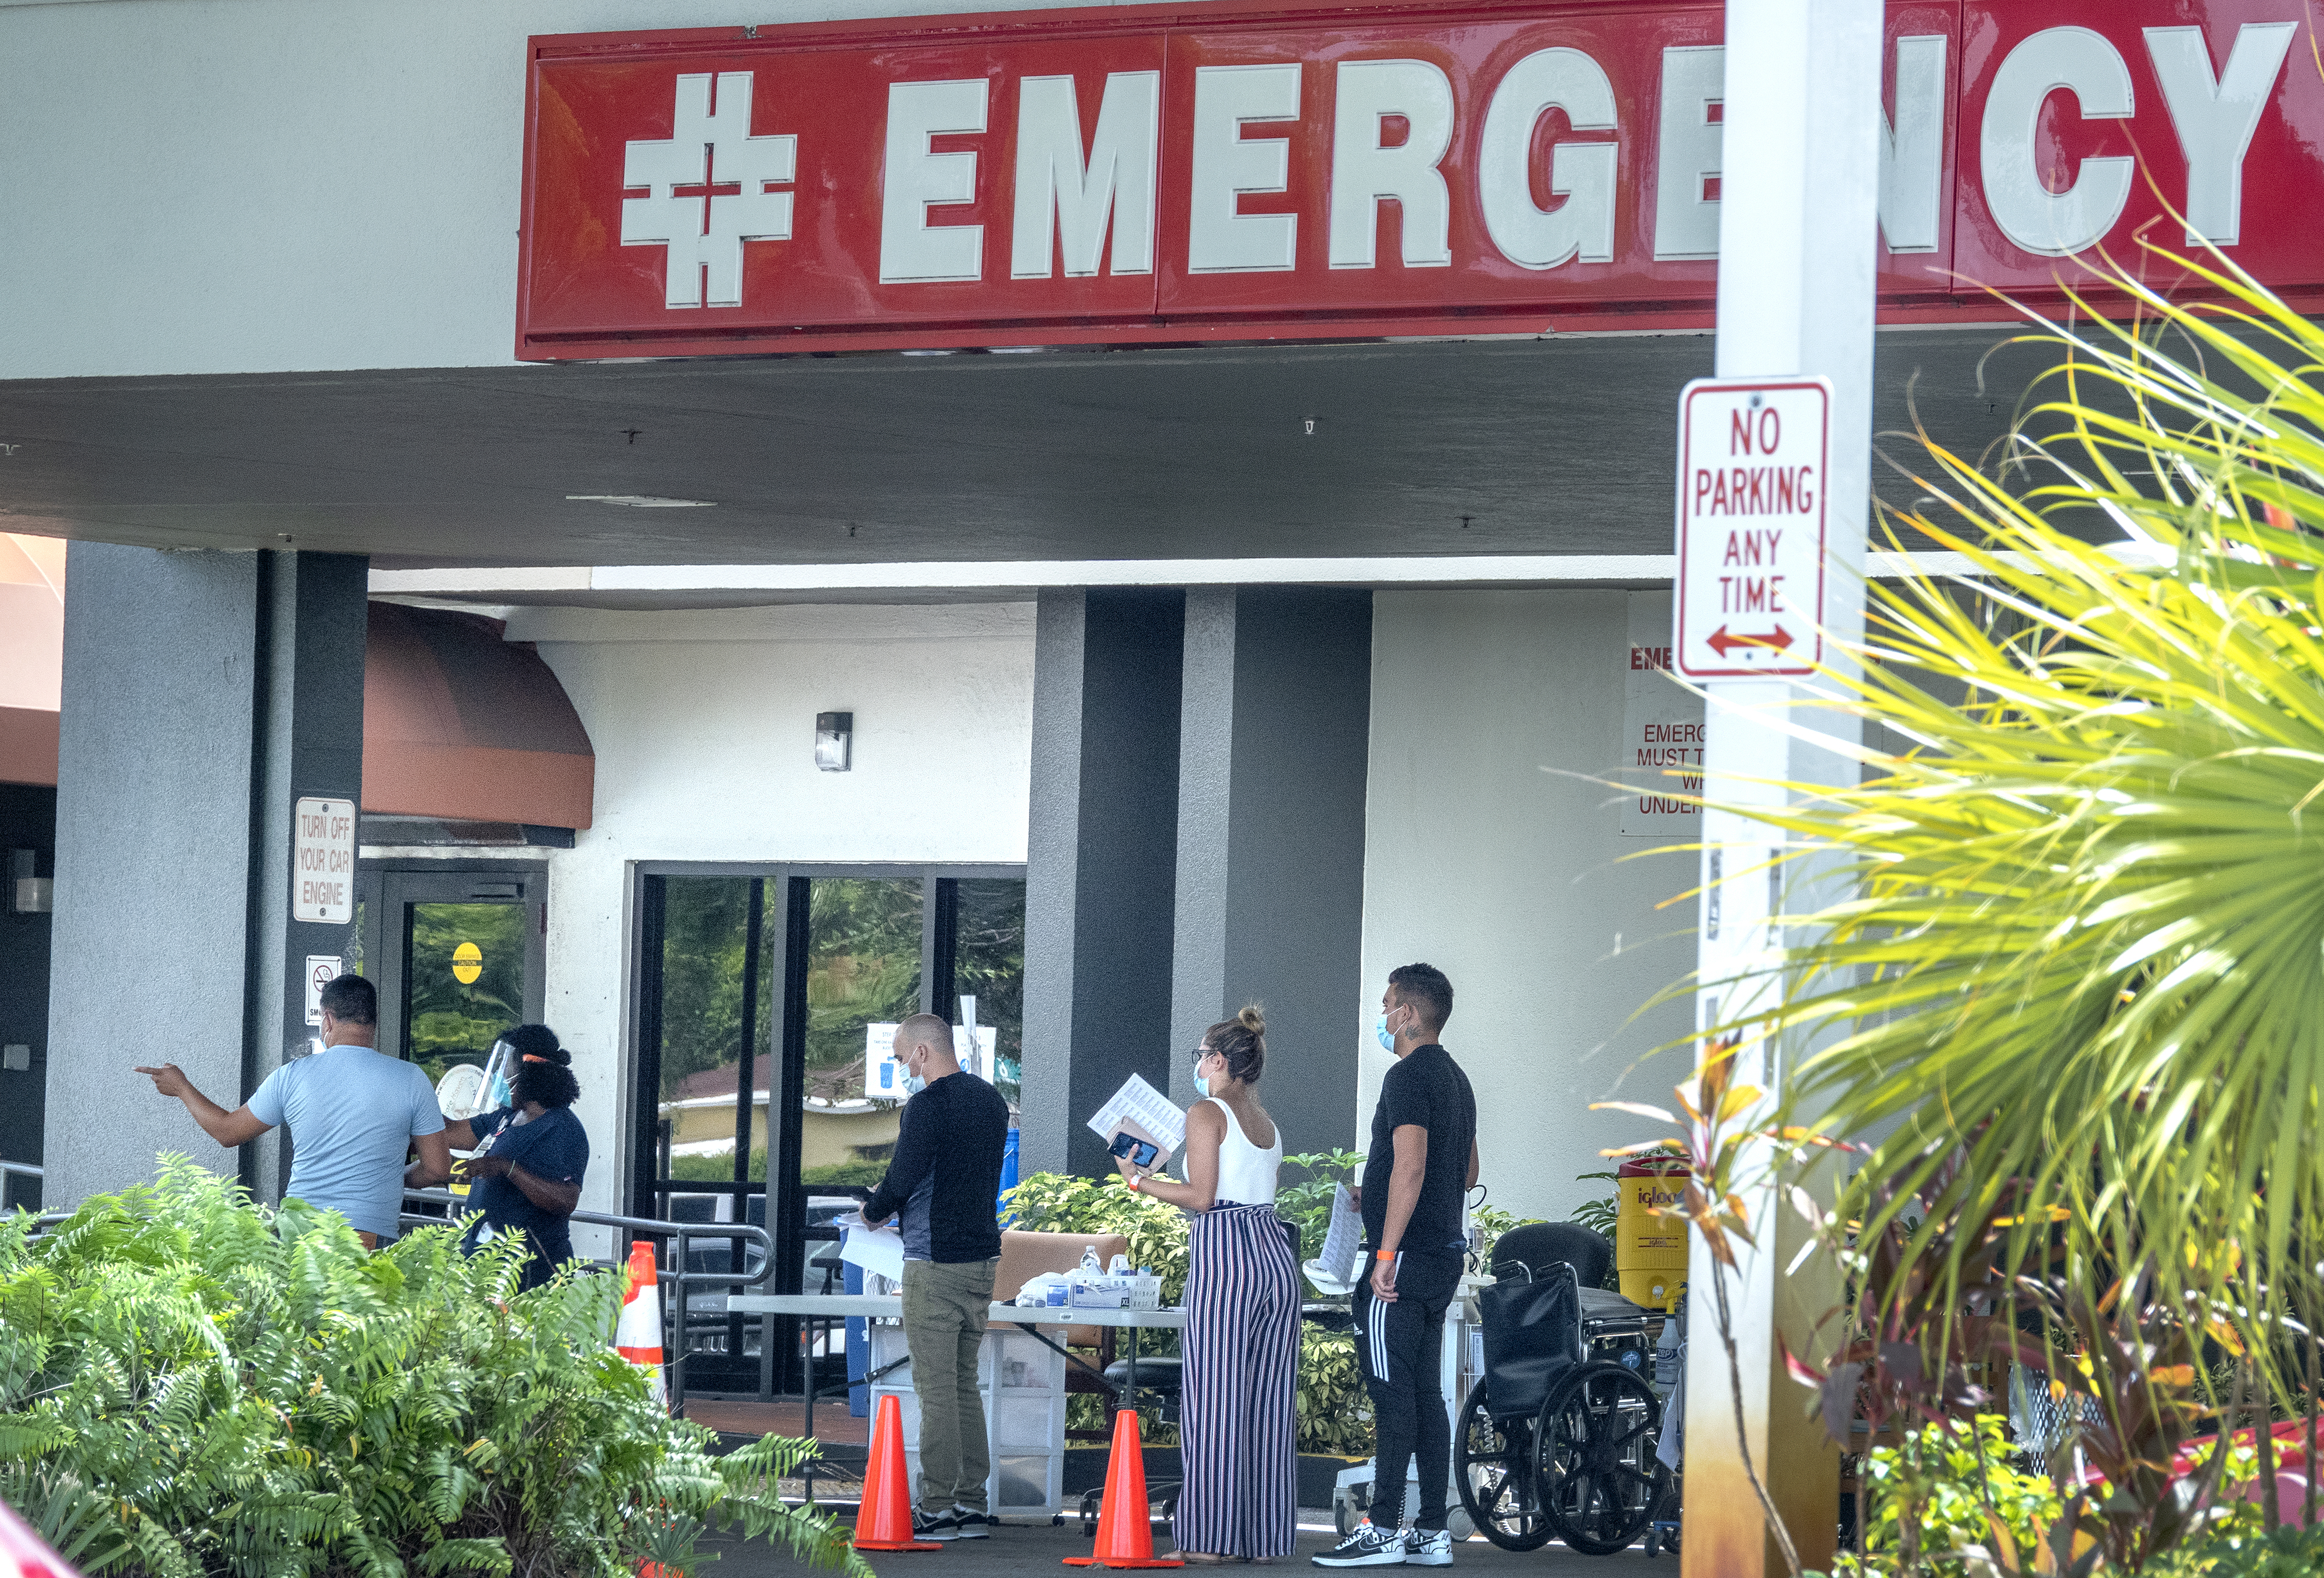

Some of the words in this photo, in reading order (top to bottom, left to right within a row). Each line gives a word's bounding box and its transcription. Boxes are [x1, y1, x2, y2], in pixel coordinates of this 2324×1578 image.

[878, 21, 2299, 285] EMERGENCY
[1730, 407, 1781, 457] NO
[1695, 465, 1814, 517] PARKING
[1723, 528, 1783, 567] ANY
[1719, 575, 1785, 614] TIME
[1631, 647, 1672, 670] EME
[1637, 748, 1689, 766] MUST
[302, 814, 327, 838] TURN
[331, 816, 350, 840] OFF
[299, 848, 325, 872] YOUR
[329, 849, 349, 873] CAR
[303, 881, 343, 905] ENGINE
[1638, 1186, 1677, 1208] igloo
[1121, 1298, 1129, 1306] XL
